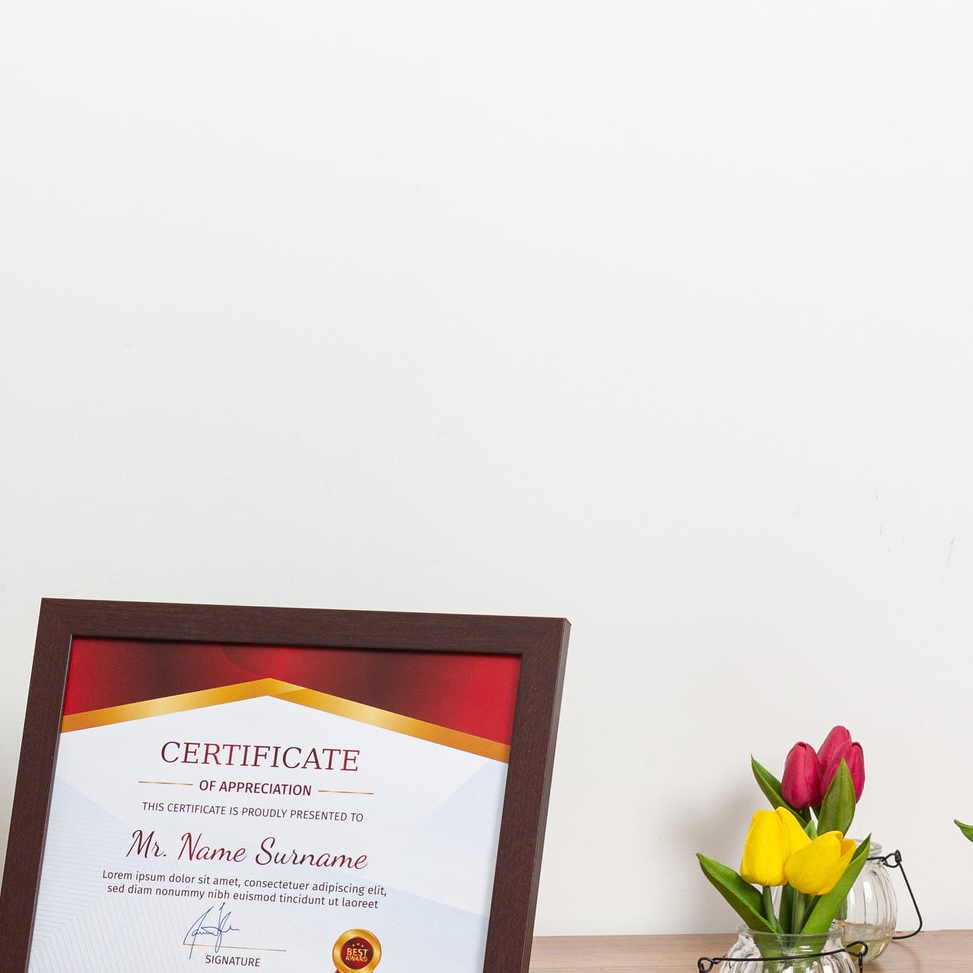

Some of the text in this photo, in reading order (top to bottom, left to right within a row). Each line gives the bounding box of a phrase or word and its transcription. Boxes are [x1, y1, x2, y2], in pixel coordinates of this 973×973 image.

[161, 741, 360, 772] CERTIFICATE
[199, 780, 312, 796] OF APPRECIATION
[142, 802, 364, 822] THIS CERTIFICATE IS PROUDLY PRESENTED TO
[126, 829, 368, 869] Mr. Name Surname
[102, 870, 387, 897] Lorem ipsum dolor sit amet, consectetuer adipiscing elit,
[107, 883, 378, 908] sed diam nonummy nibh euismod tincidunt ut laoreet
[205, 954, 261, 967] SIGNATURE
[346, 948, 369, 957] BEST
